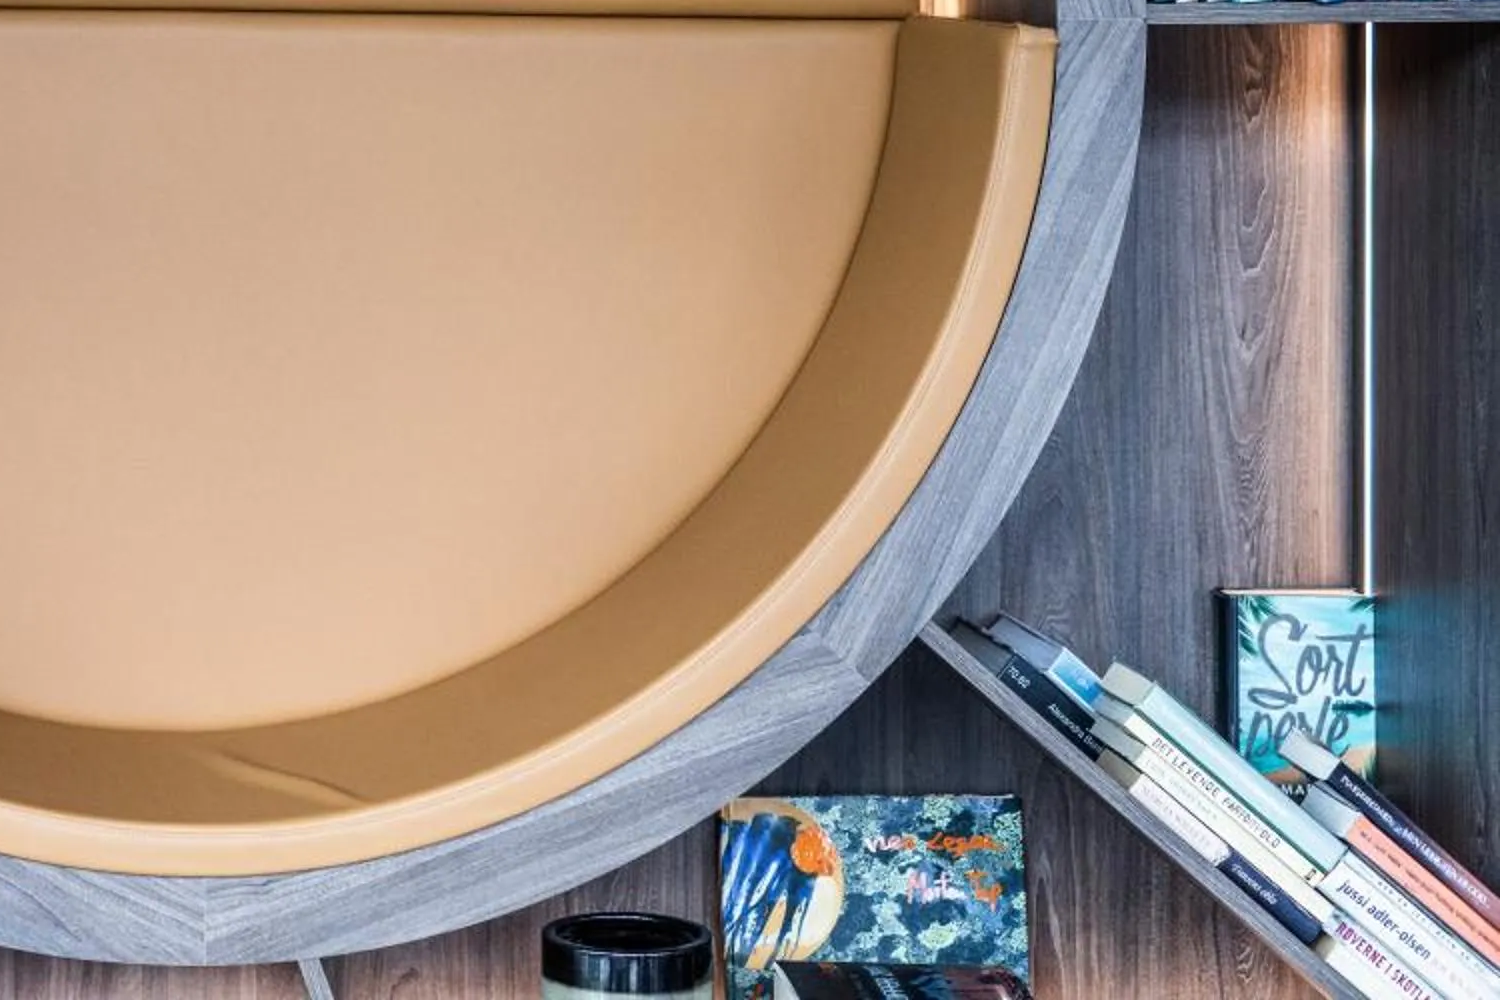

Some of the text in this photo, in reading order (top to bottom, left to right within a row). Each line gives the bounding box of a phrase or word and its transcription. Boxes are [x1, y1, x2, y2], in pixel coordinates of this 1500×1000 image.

[1248, 613, 1376, 710] Sort
[1152, 737, 1175, 763] DET
[1171, 756, 1220, 799] LEVENDE
[1335, 921, 1387, 969] RØVERNE
[1336, 880, 1432, 960] jussi adler-olsen
